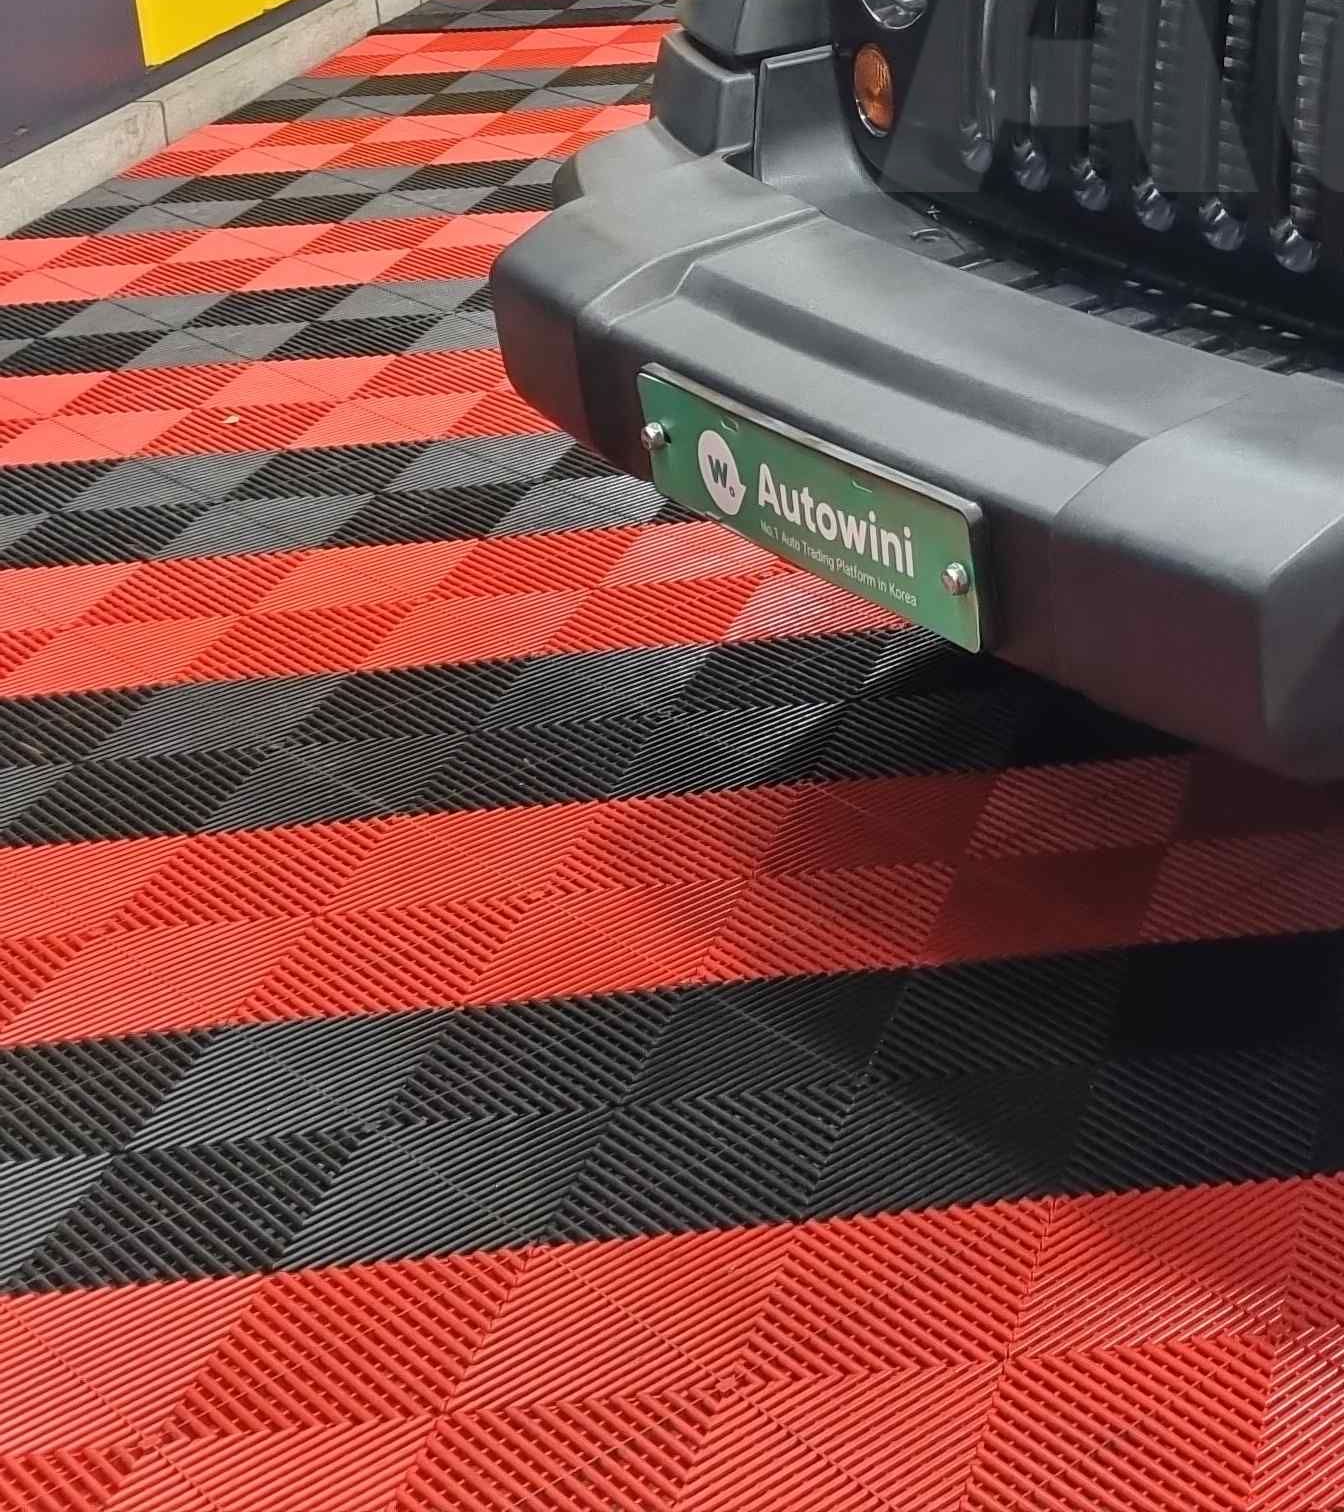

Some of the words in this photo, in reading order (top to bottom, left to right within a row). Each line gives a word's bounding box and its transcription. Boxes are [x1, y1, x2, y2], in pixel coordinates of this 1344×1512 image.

[757, 463, 915, 578] Autowini
[781, 529, 802, 551] Auto
[802, 541, 835, 571] Trading
[836, 557, 878, 587] Platform
[878, 576, 888, 593] in
[889, 582, 918, 607] Korea
